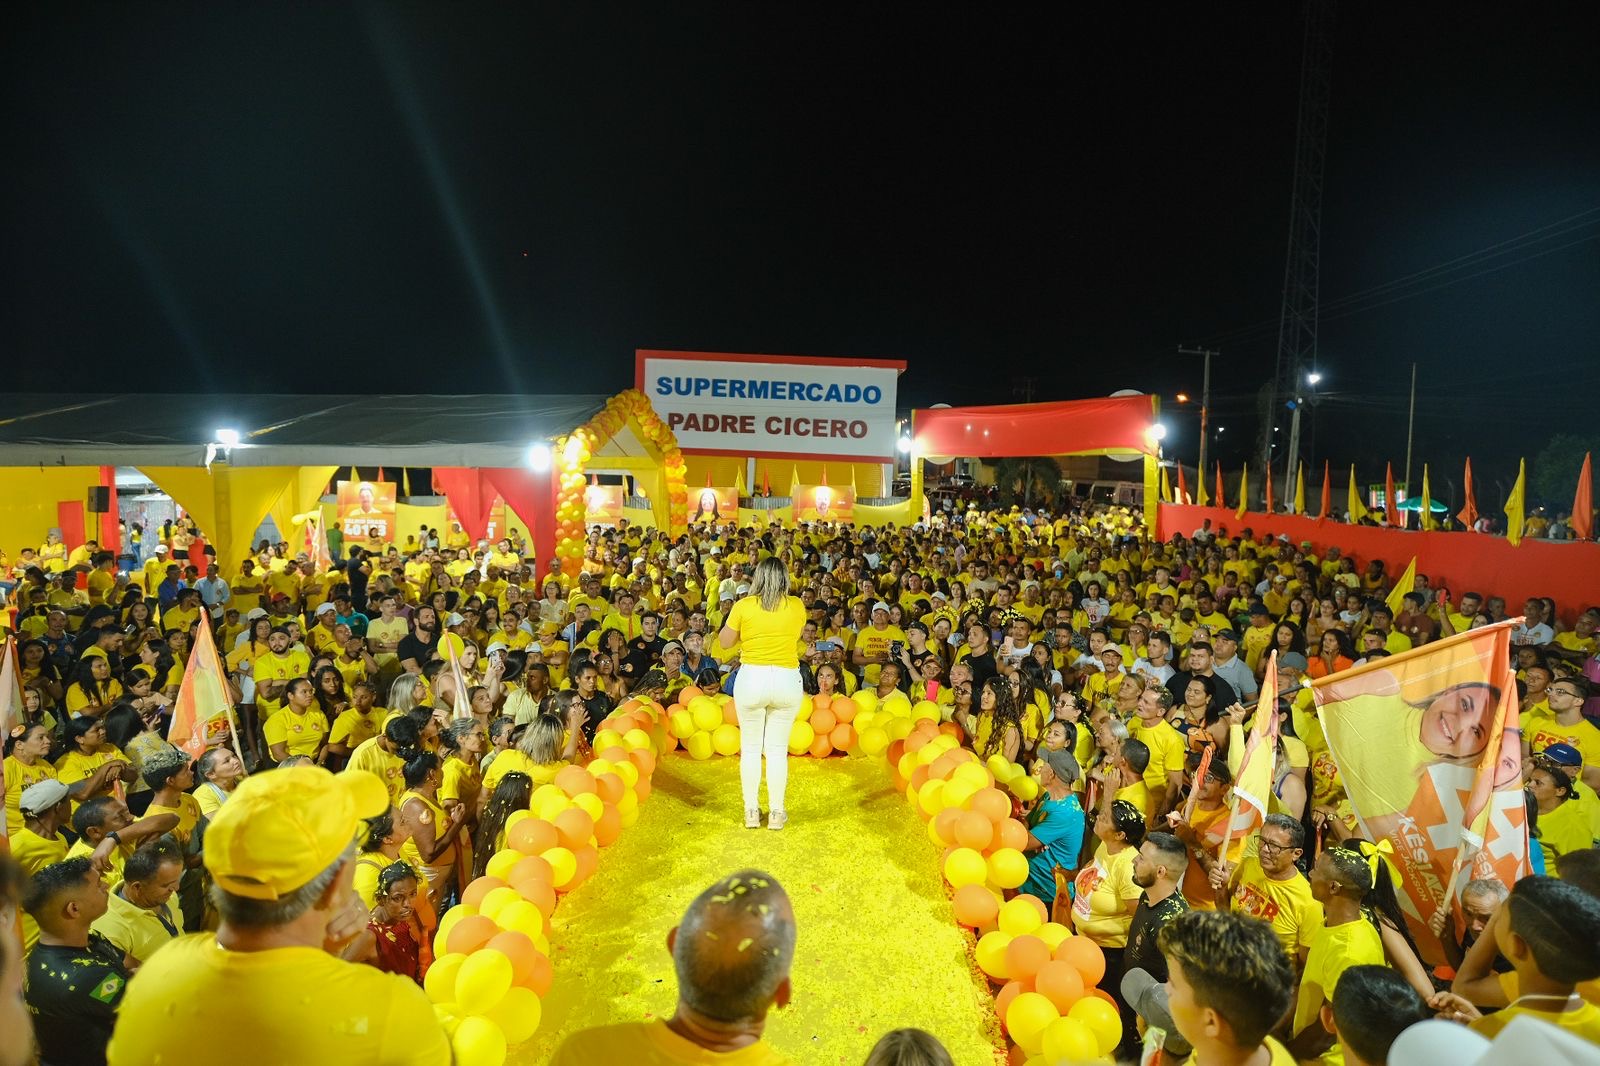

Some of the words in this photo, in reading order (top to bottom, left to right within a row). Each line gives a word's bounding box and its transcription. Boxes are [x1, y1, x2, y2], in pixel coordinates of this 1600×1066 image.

[656, 376, 881, 404] SUPERMERCADO
[668, 412, 756, 434] PADRE
[764, 416, 868, 438] CICERO
[1389, 829, 1405, 852] VICE
[1400, 852, 1429, 902] JACKSON
[1398, 816, 1446, 898] KÉSIA
